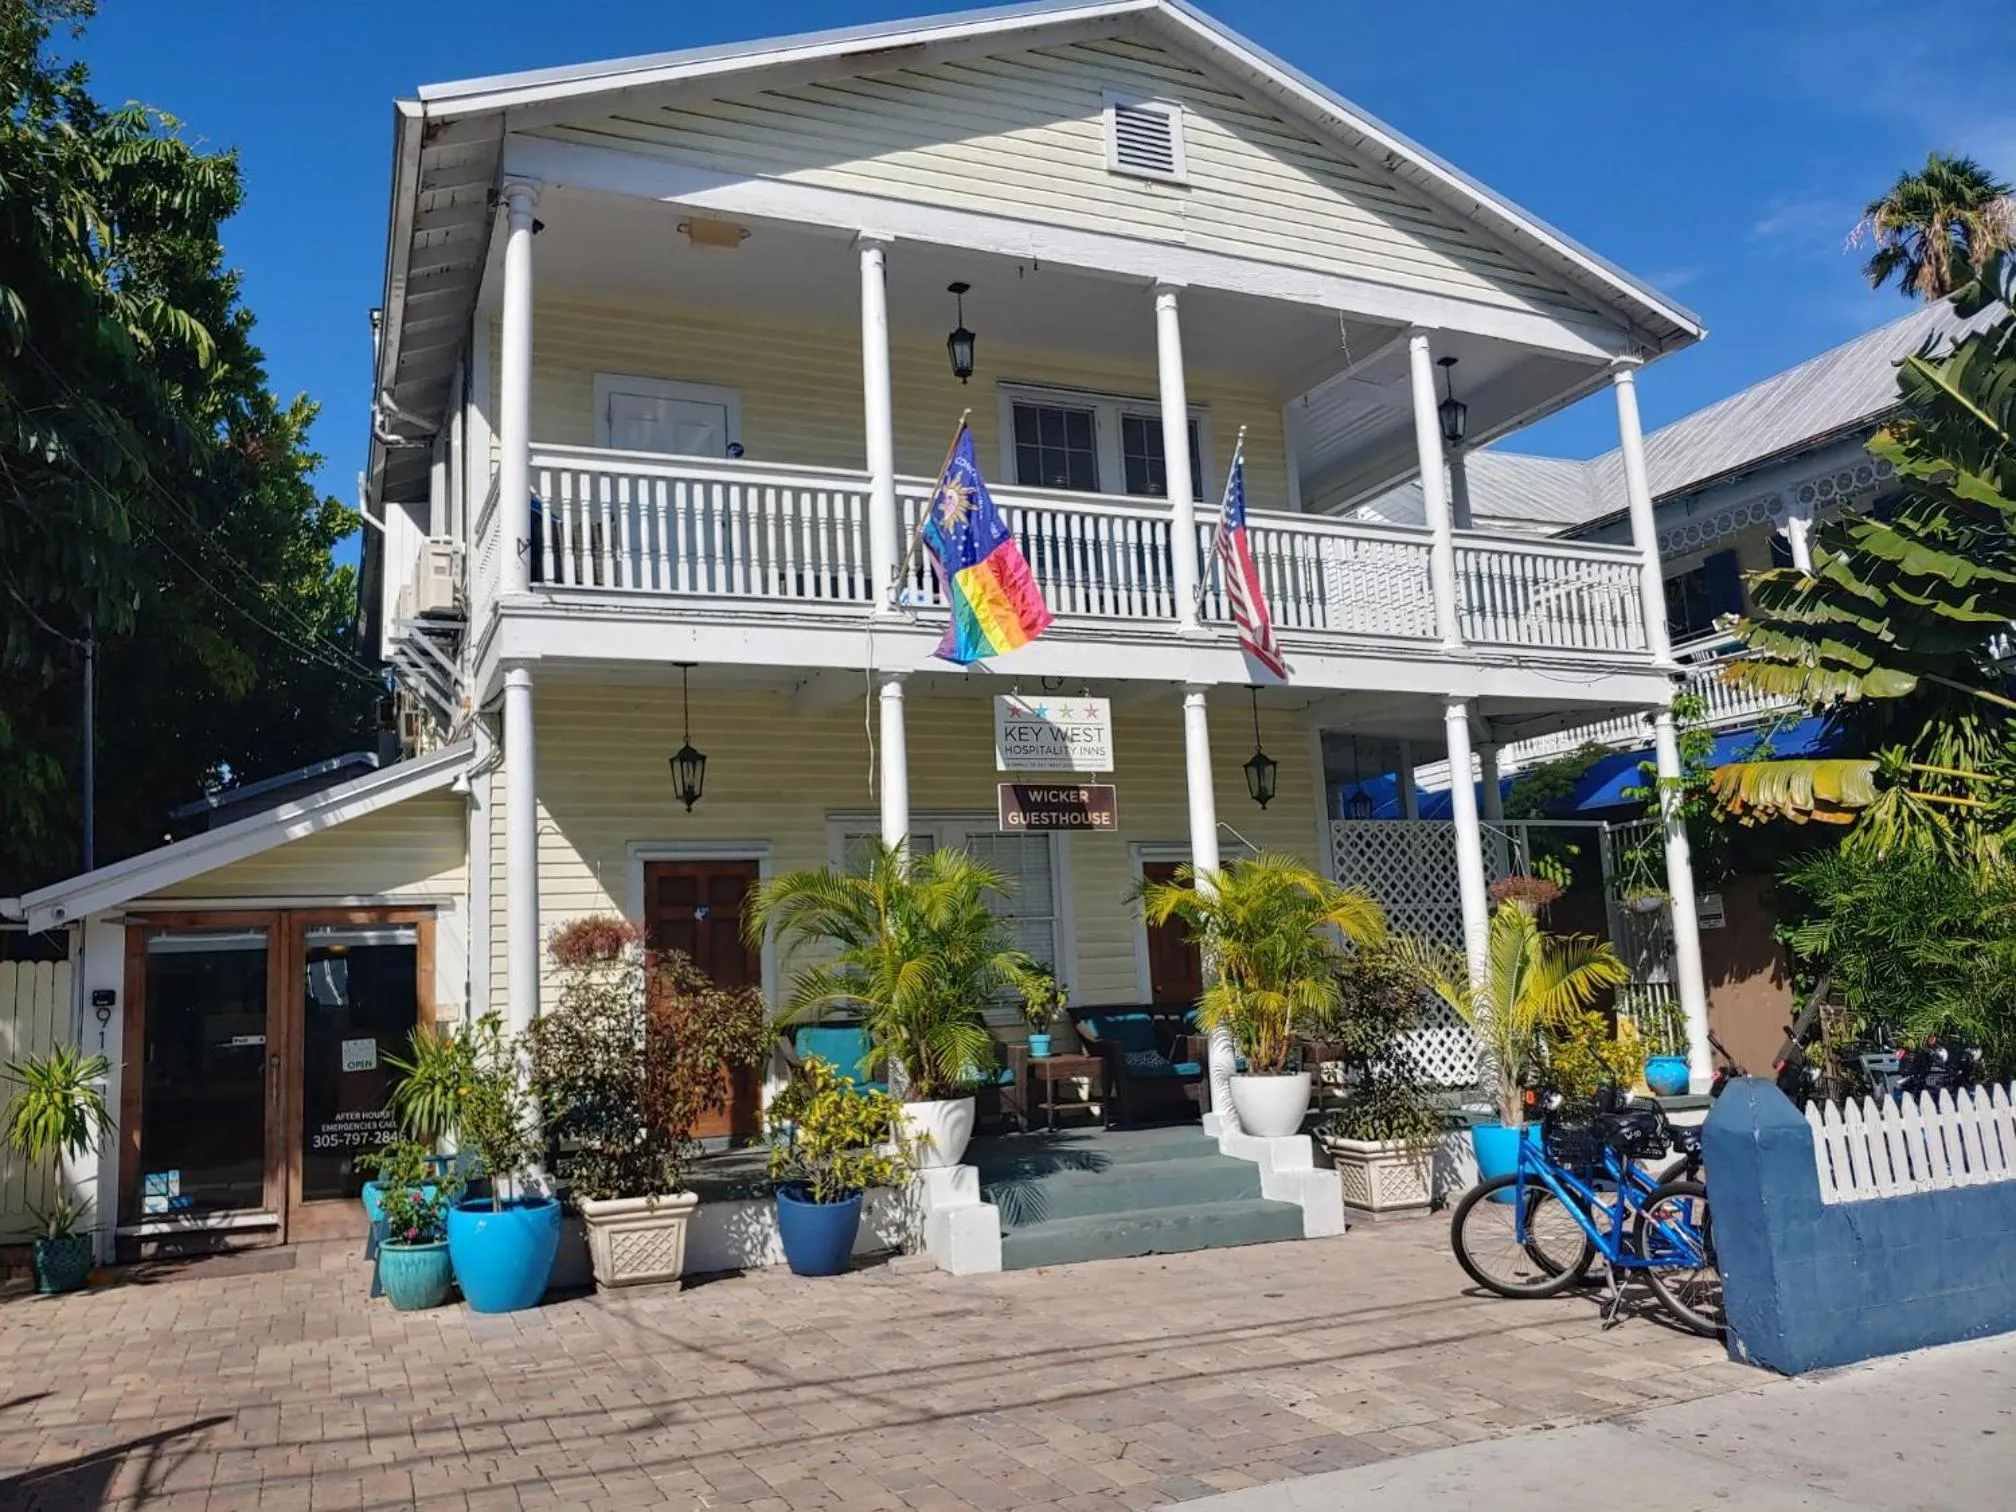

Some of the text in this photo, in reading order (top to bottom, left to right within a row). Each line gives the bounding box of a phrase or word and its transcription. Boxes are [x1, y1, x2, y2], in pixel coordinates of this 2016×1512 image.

[1004, 726, 1105, 743] KEY WEST
[1004, 744, 1106, 756] HOSPITALITY INNS
[1028, 790, 1090, 803] WICKER
[1007, 811, 1111, 825] GUESTHOUSE
[347, 1060, 373, 1069] OPEN
[335, 1112, 361, 1121] AFTER
[321, 1121, 378, 1132] EMERGENCIES
